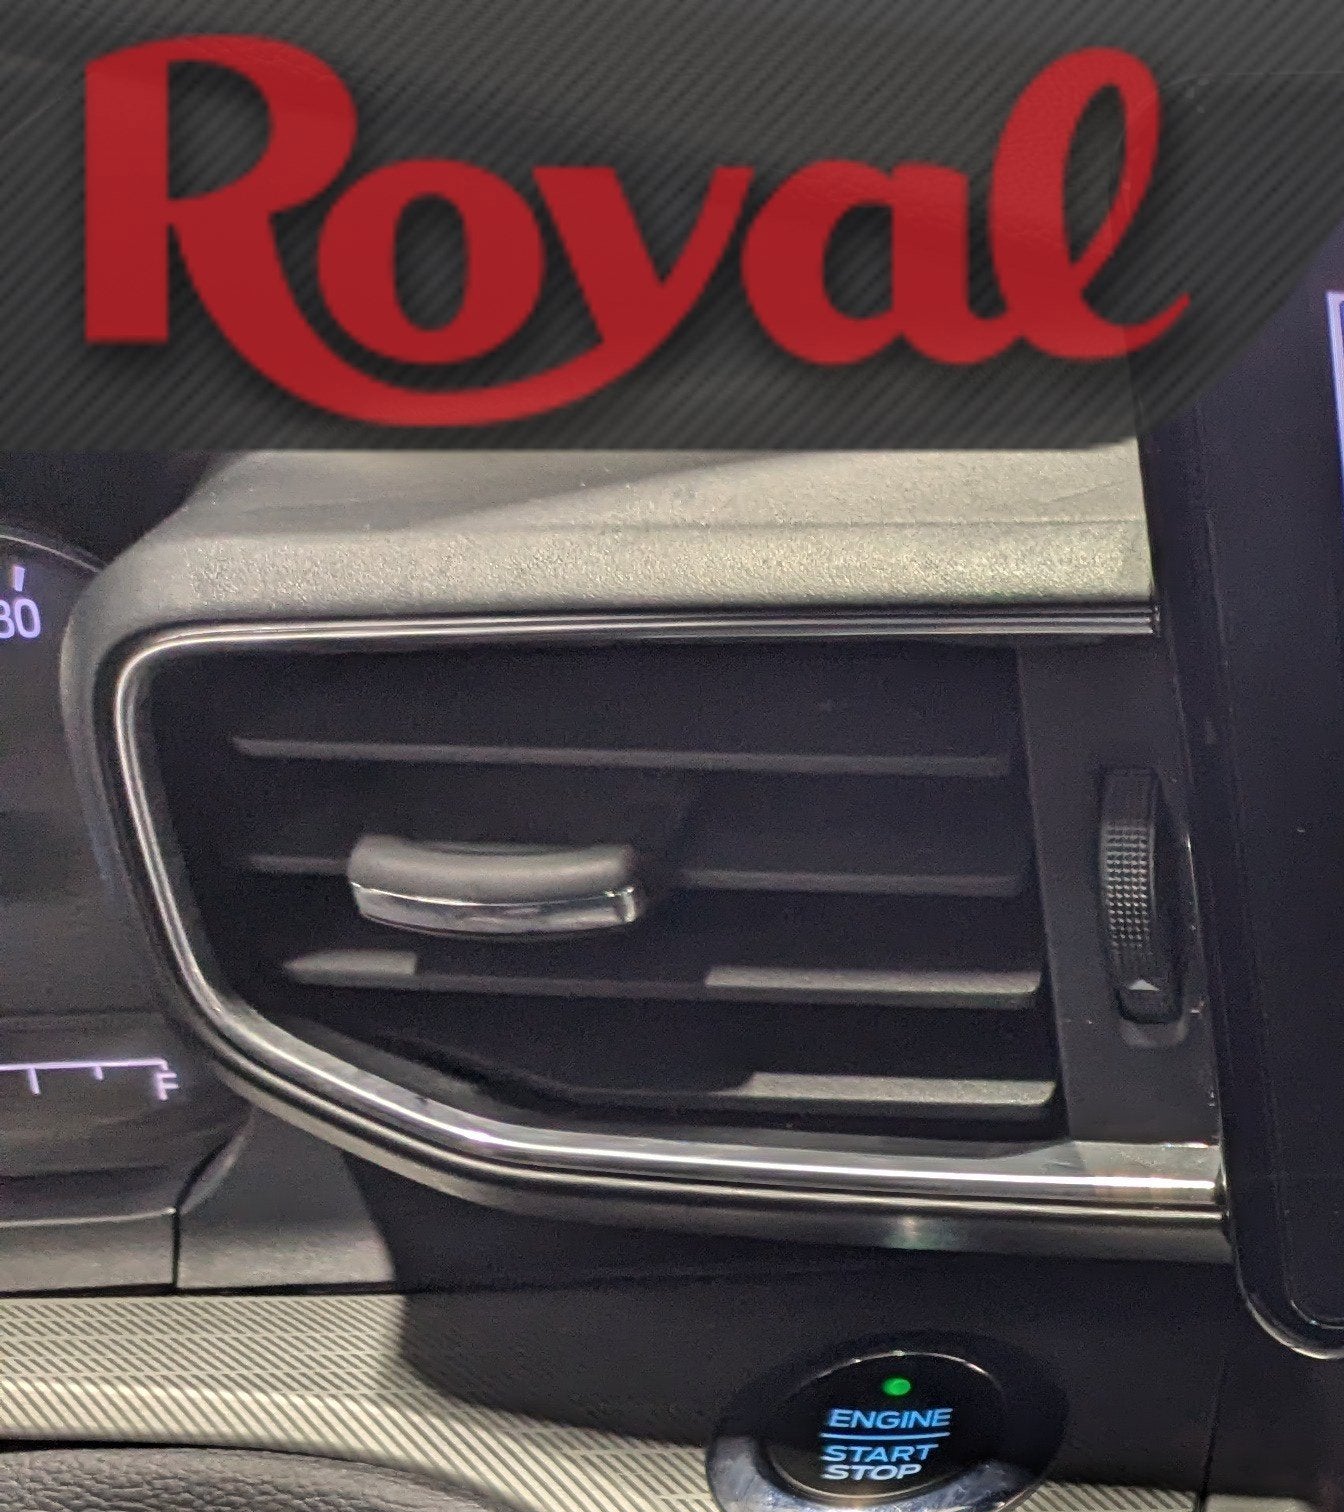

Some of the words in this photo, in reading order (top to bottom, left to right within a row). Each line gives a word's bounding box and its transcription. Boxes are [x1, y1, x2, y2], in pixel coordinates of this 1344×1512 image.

[154, 1072, 178, 1101] F
[829, 1407, 953, 1430] ENGINE
[820, 1443, 939, 1463] START
[821, 1463, 922, 1481] STOP
